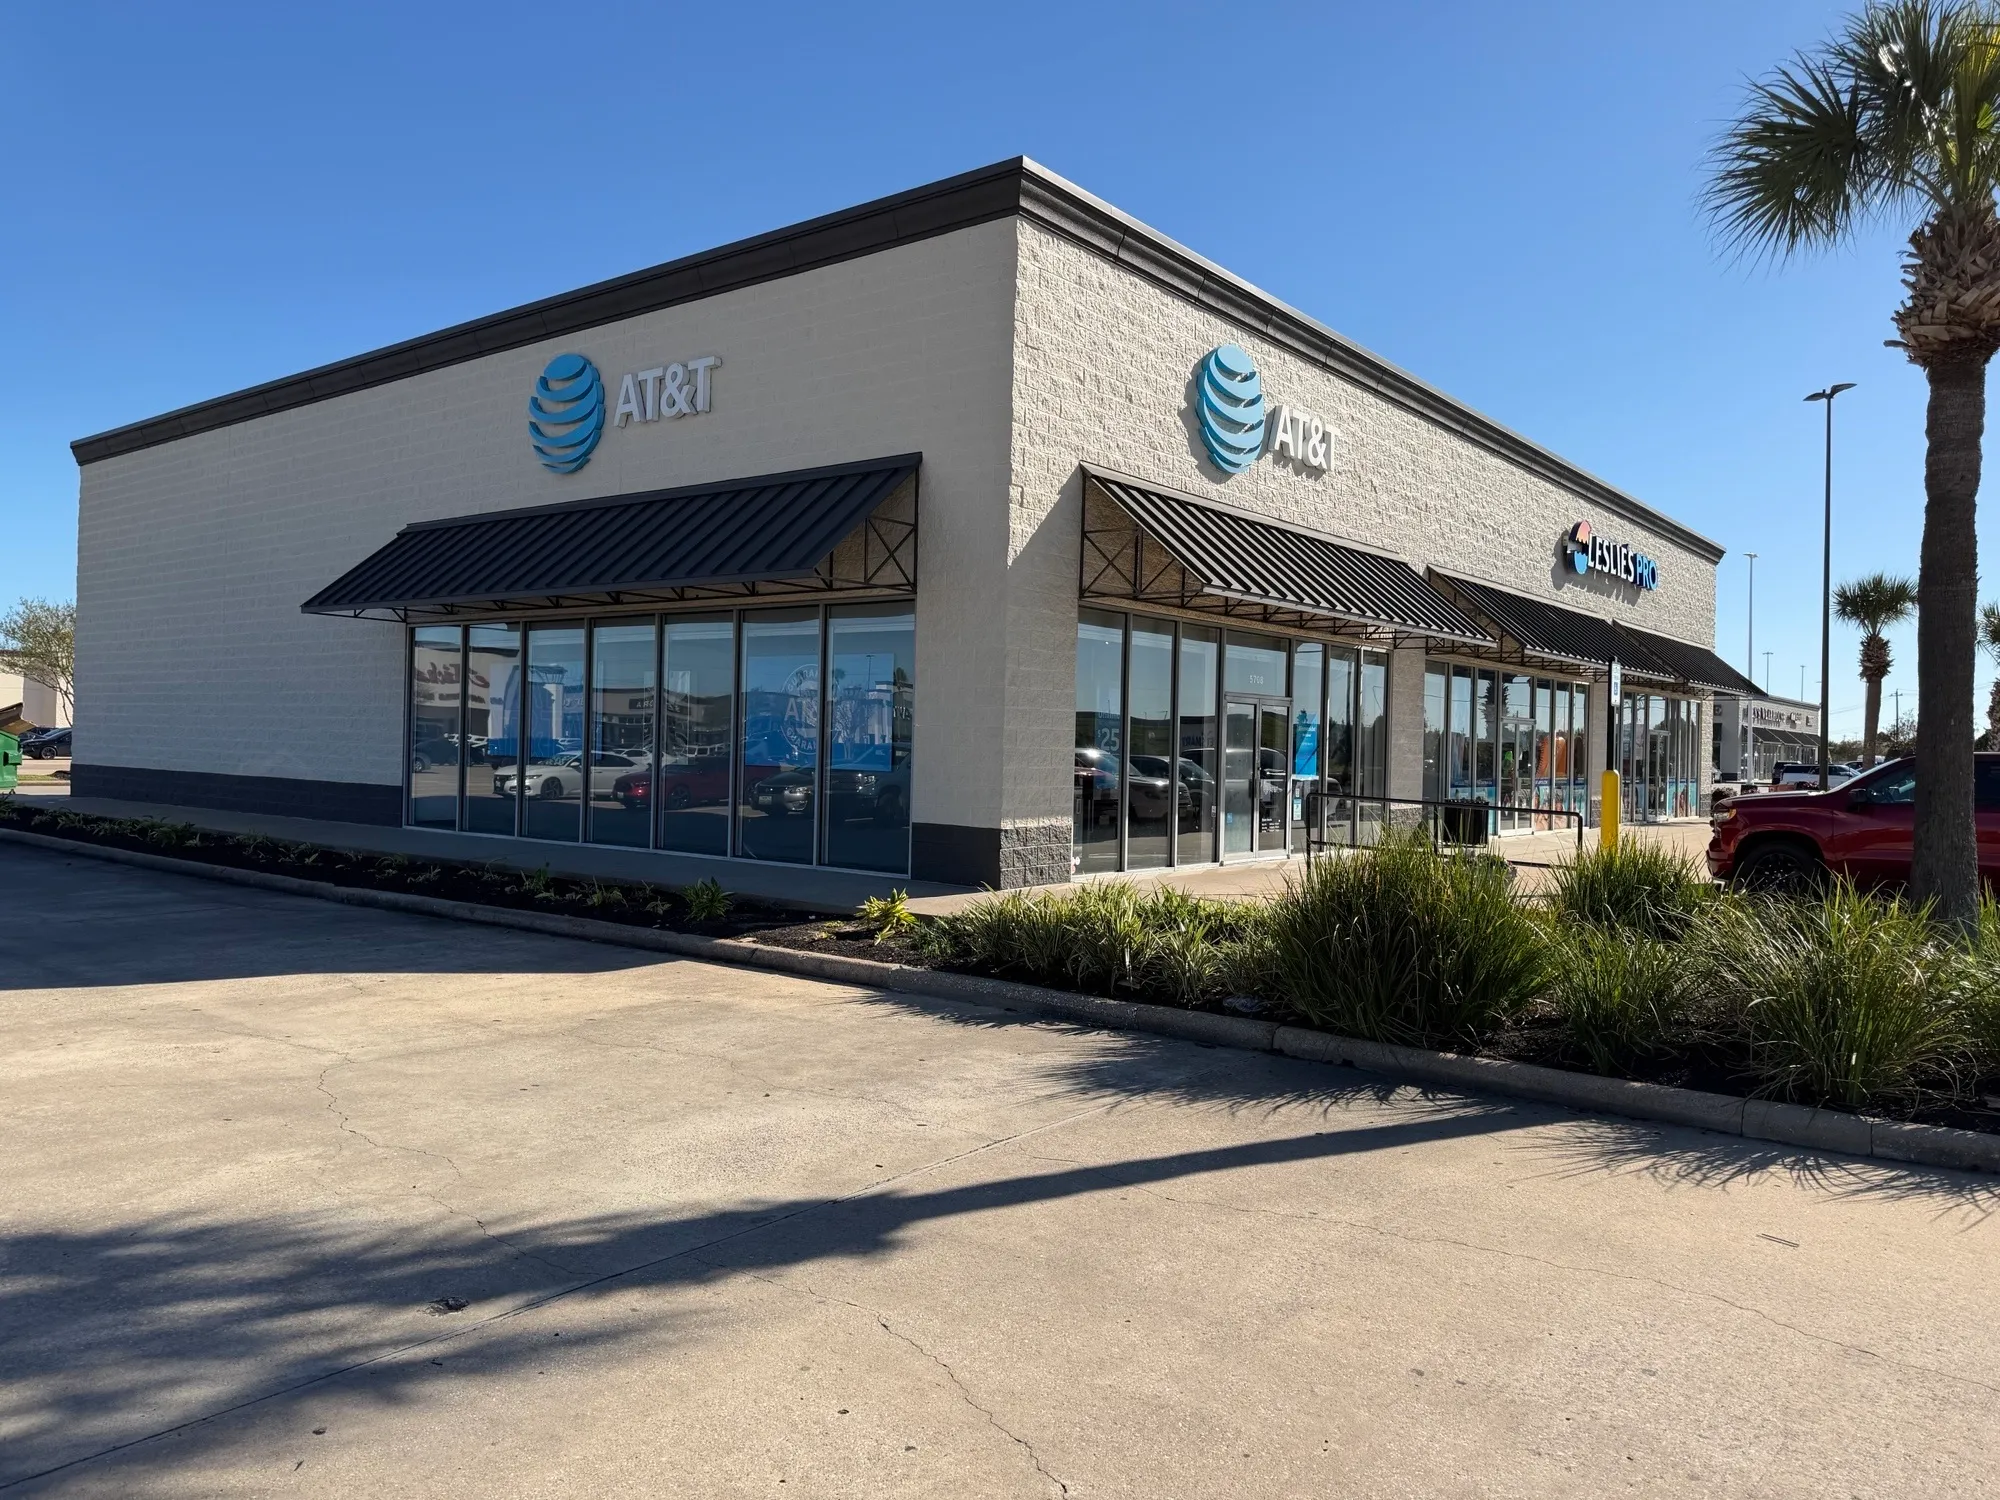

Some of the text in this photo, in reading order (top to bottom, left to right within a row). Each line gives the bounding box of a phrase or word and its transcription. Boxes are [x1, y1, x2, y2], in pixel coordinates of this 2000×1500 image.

[613, 356, 721, 428] AT&T
[1270, 404, 1341, 471] AT&T
[1635, 552, 1660, 591] PRO
